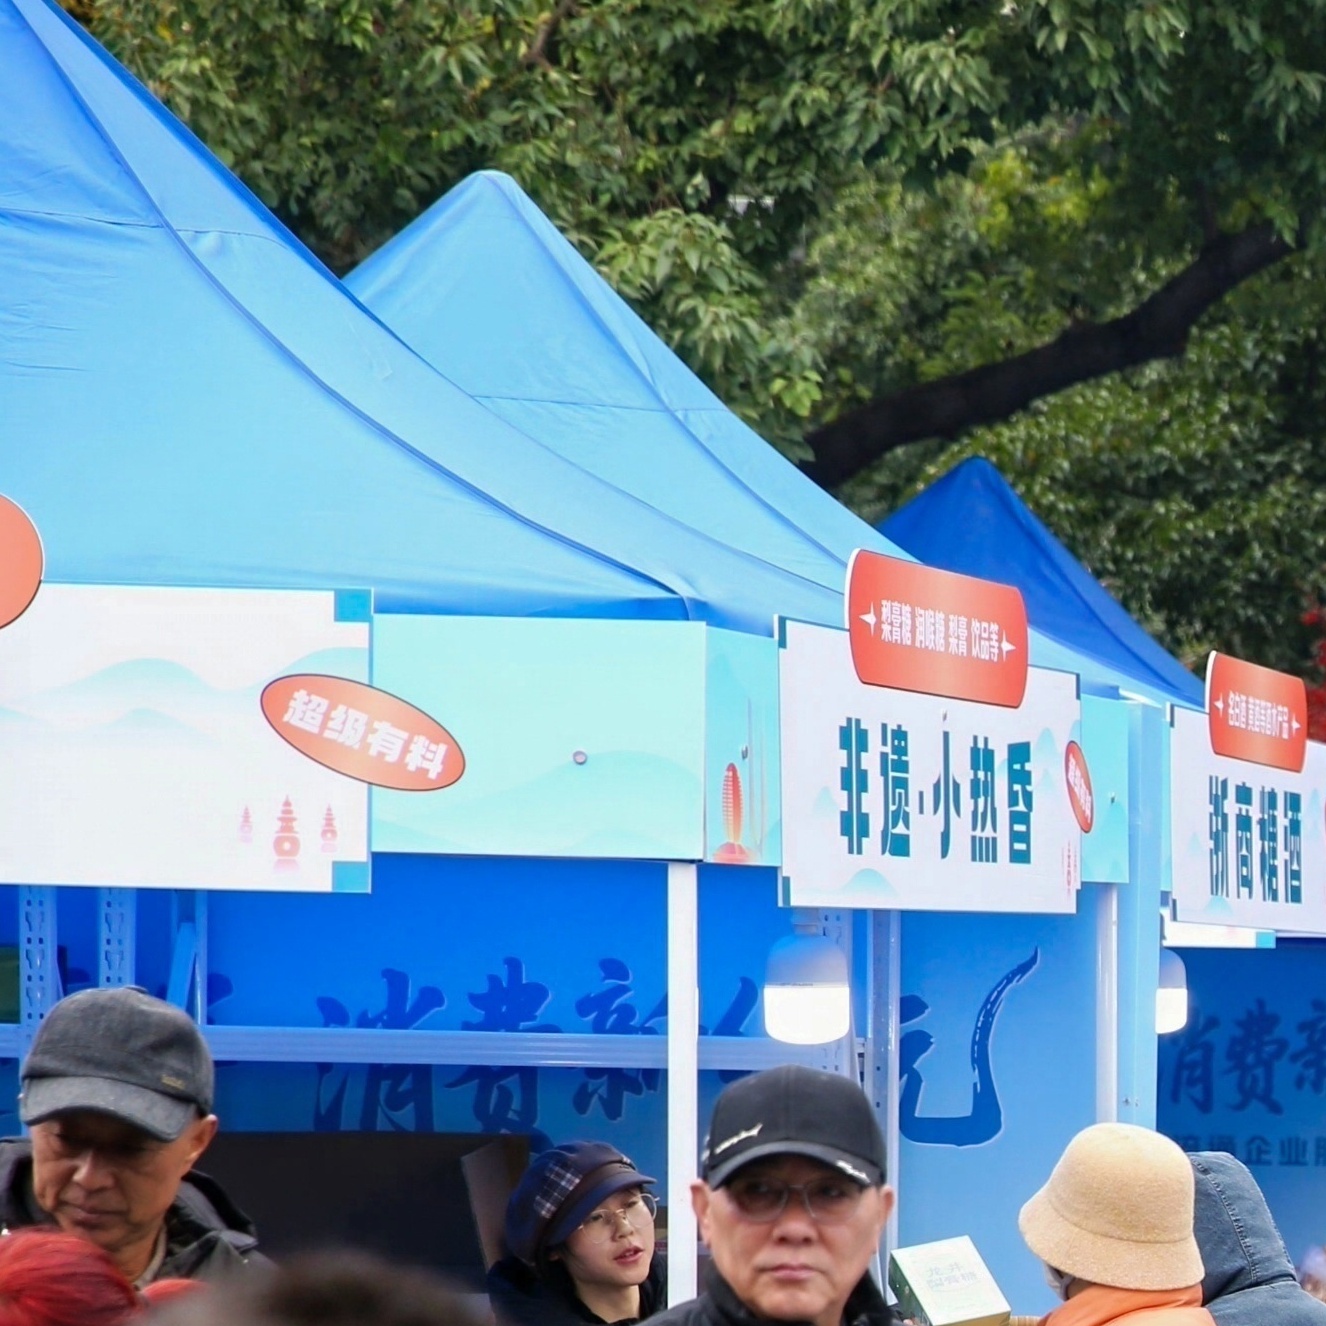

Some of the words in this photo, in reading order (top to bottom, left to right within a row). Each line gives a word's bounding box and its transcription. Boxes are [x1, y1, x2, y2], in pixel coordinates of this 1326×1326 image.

[283, 689, 449, 780] 超级有料
[839, 716, 1033, 864] 非遗·小热昏
[1208, 774, 1302, 904] 浙商糖酒
